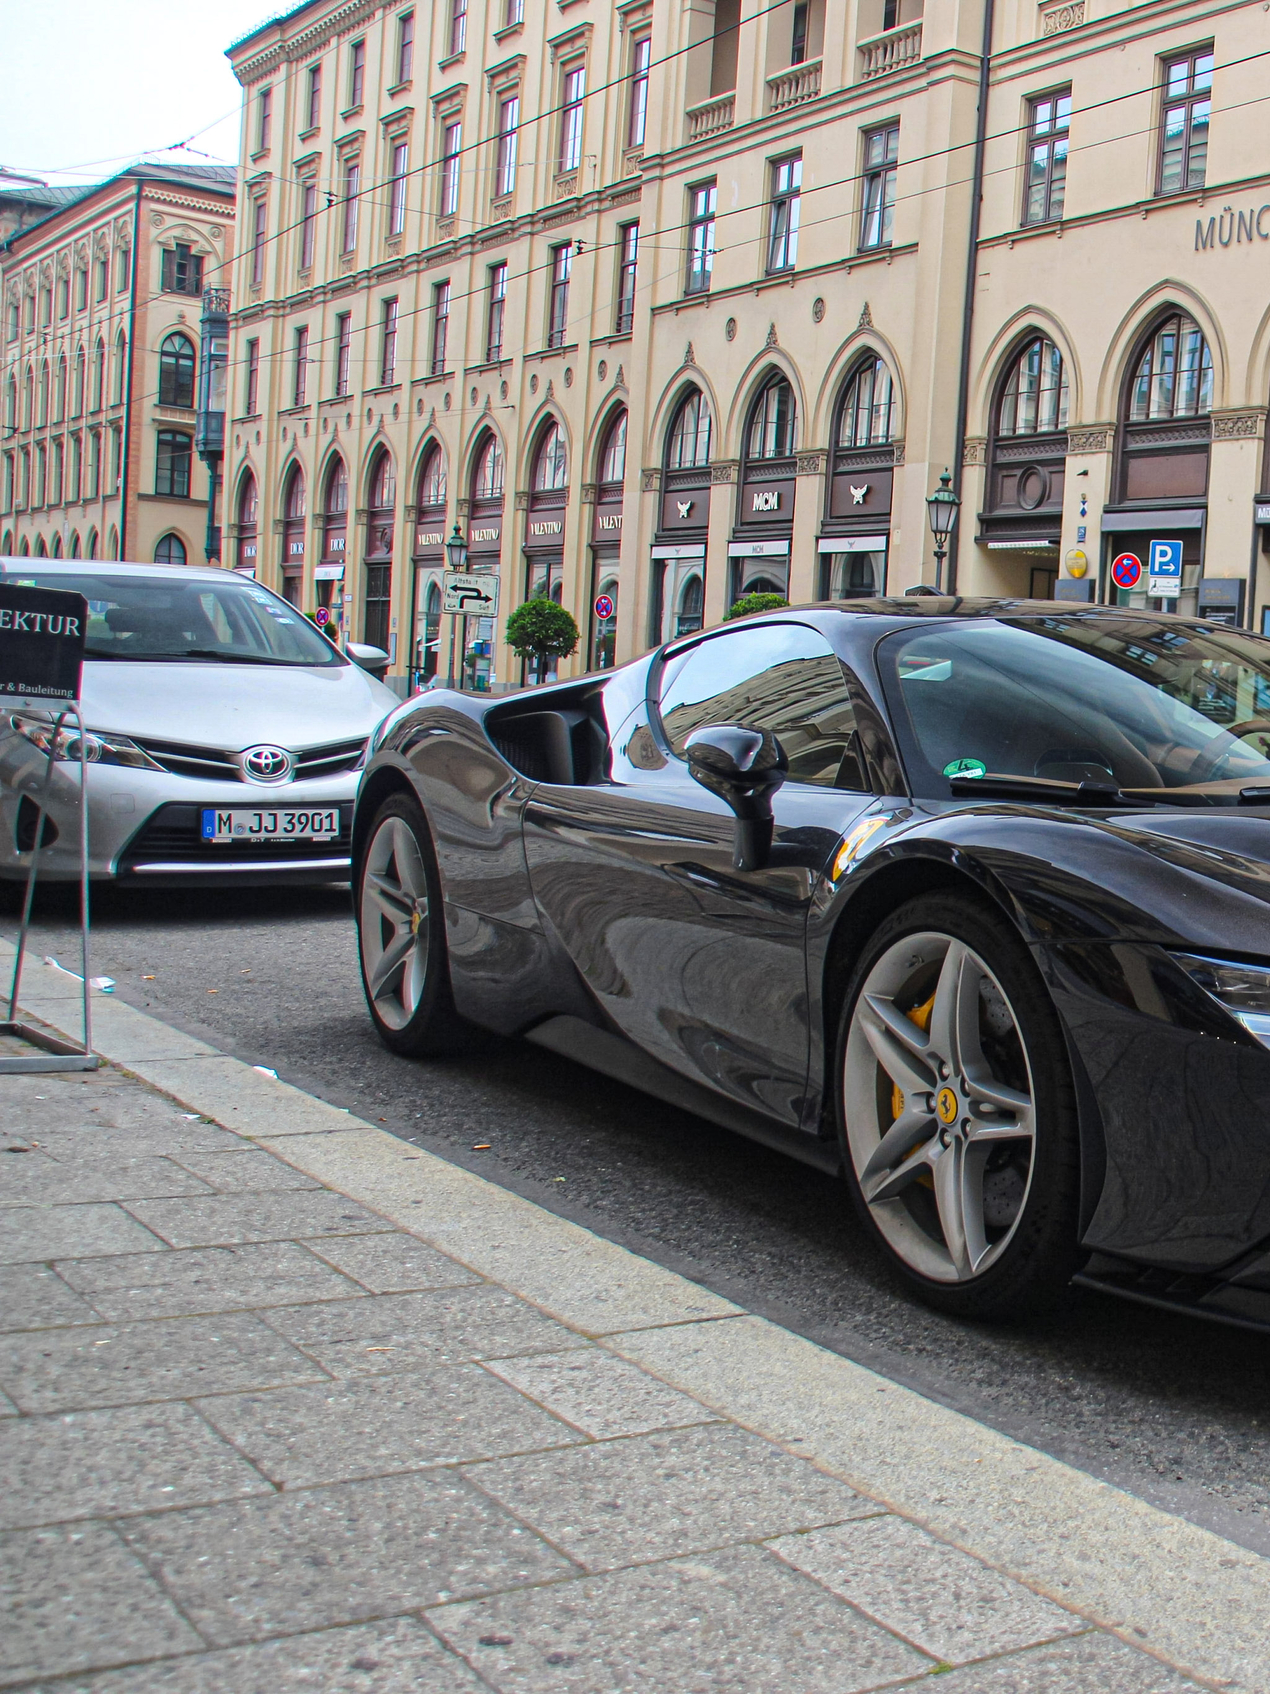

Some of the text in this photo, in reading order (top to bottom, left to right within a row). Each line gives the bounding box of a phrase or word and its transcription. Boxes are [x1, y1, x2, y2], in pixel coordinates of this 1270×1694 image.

[752, 491, 779, 512] MCM
[471, 528, 500, 543] VALENTINO
[531, 520, 562, 536] VALENTINO
[330, 538, 345, 552] DIOR
[418, 532, 444, 546] VALENTINO
[244, 545, 257, 558] DIOR
[290, 542, 304, 555] DIOR
[1154, 545, 1173, 572] P
[7, 682, 15, 691] &
[18, 683, 74, 698] Bauleitung
[217, 812, 337, 834] M JJ 3901
